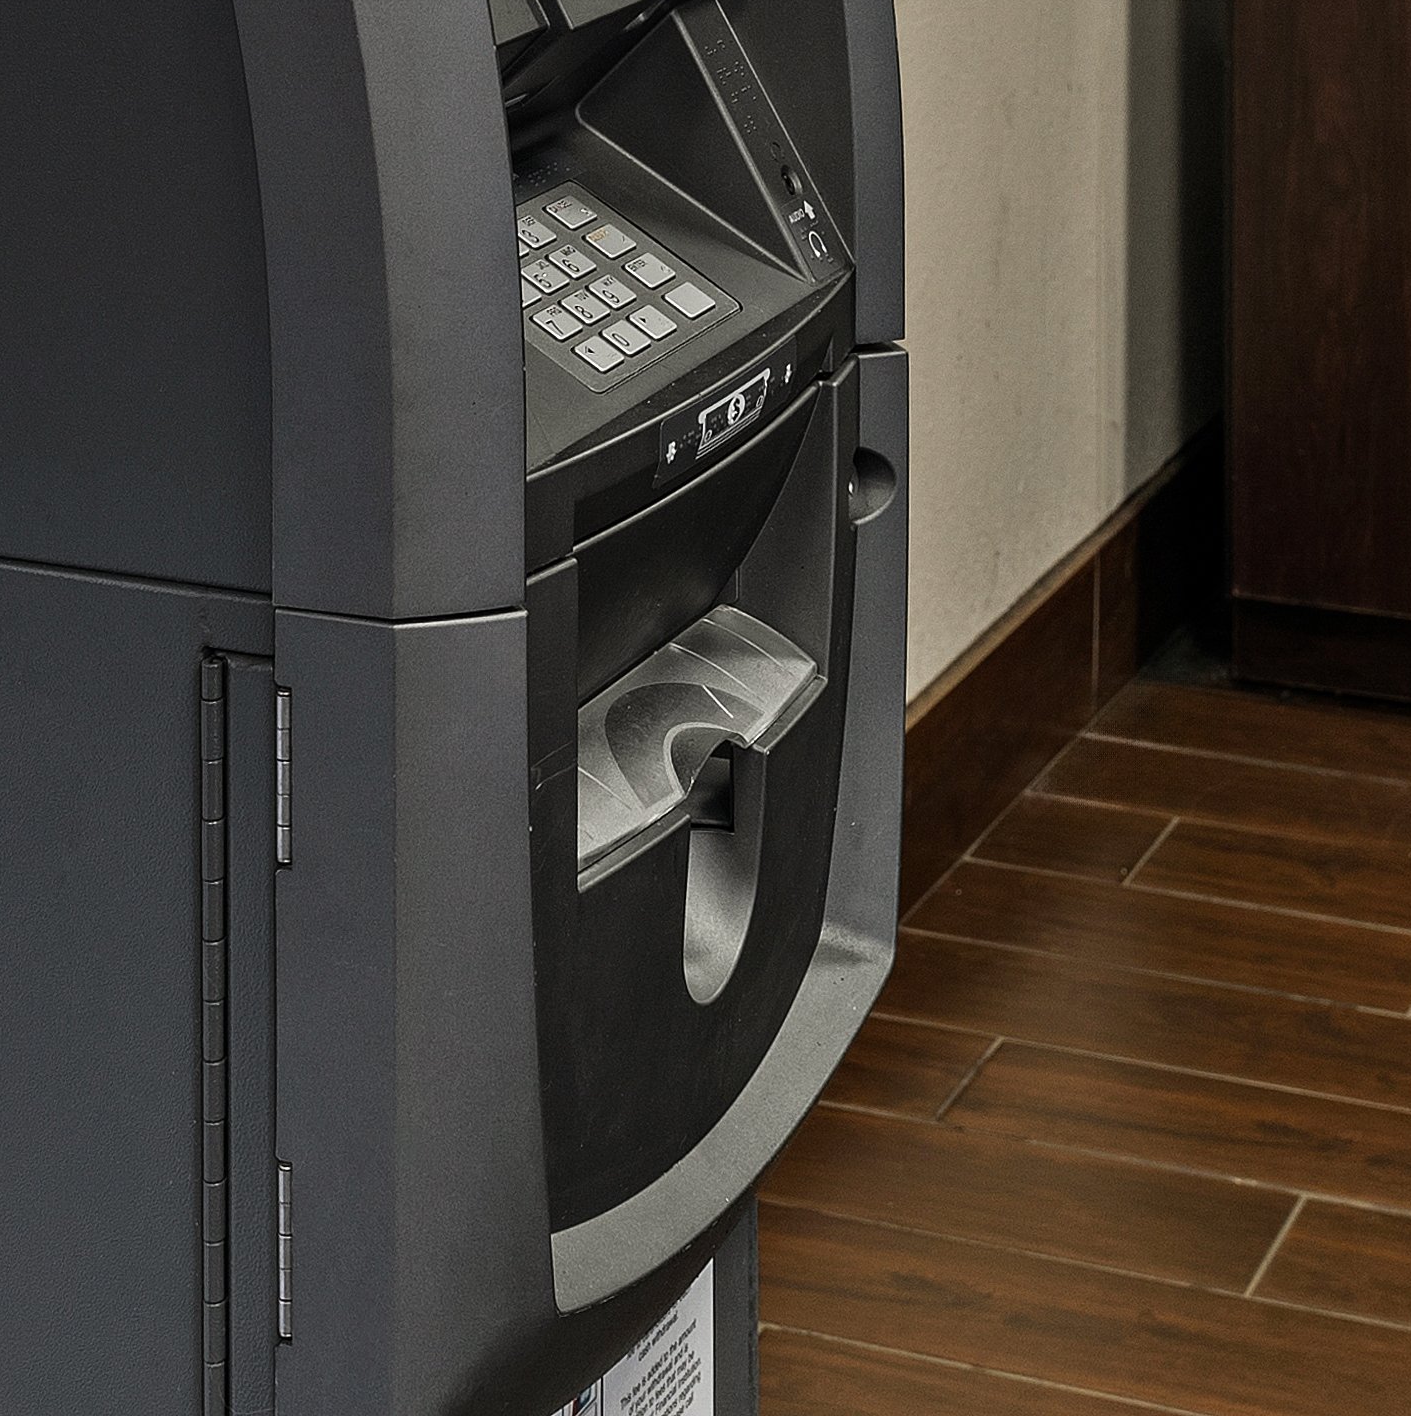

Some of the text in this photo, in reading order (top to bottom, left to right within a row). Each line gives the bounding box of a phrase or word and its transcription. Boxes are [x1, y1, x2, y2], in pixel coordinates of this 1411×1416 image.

[789, 208, 805, 224] AUDIO
[522, 229, 540, 244] 3
[562, 259, 580, 272] 6
[534, 274, 552, 288] 5
[602, 290, 620, 303] 9
[575, 305, 593, 319] 8
[545, 320, 564, 335] 7
[612, 333, 630, 346] 0
